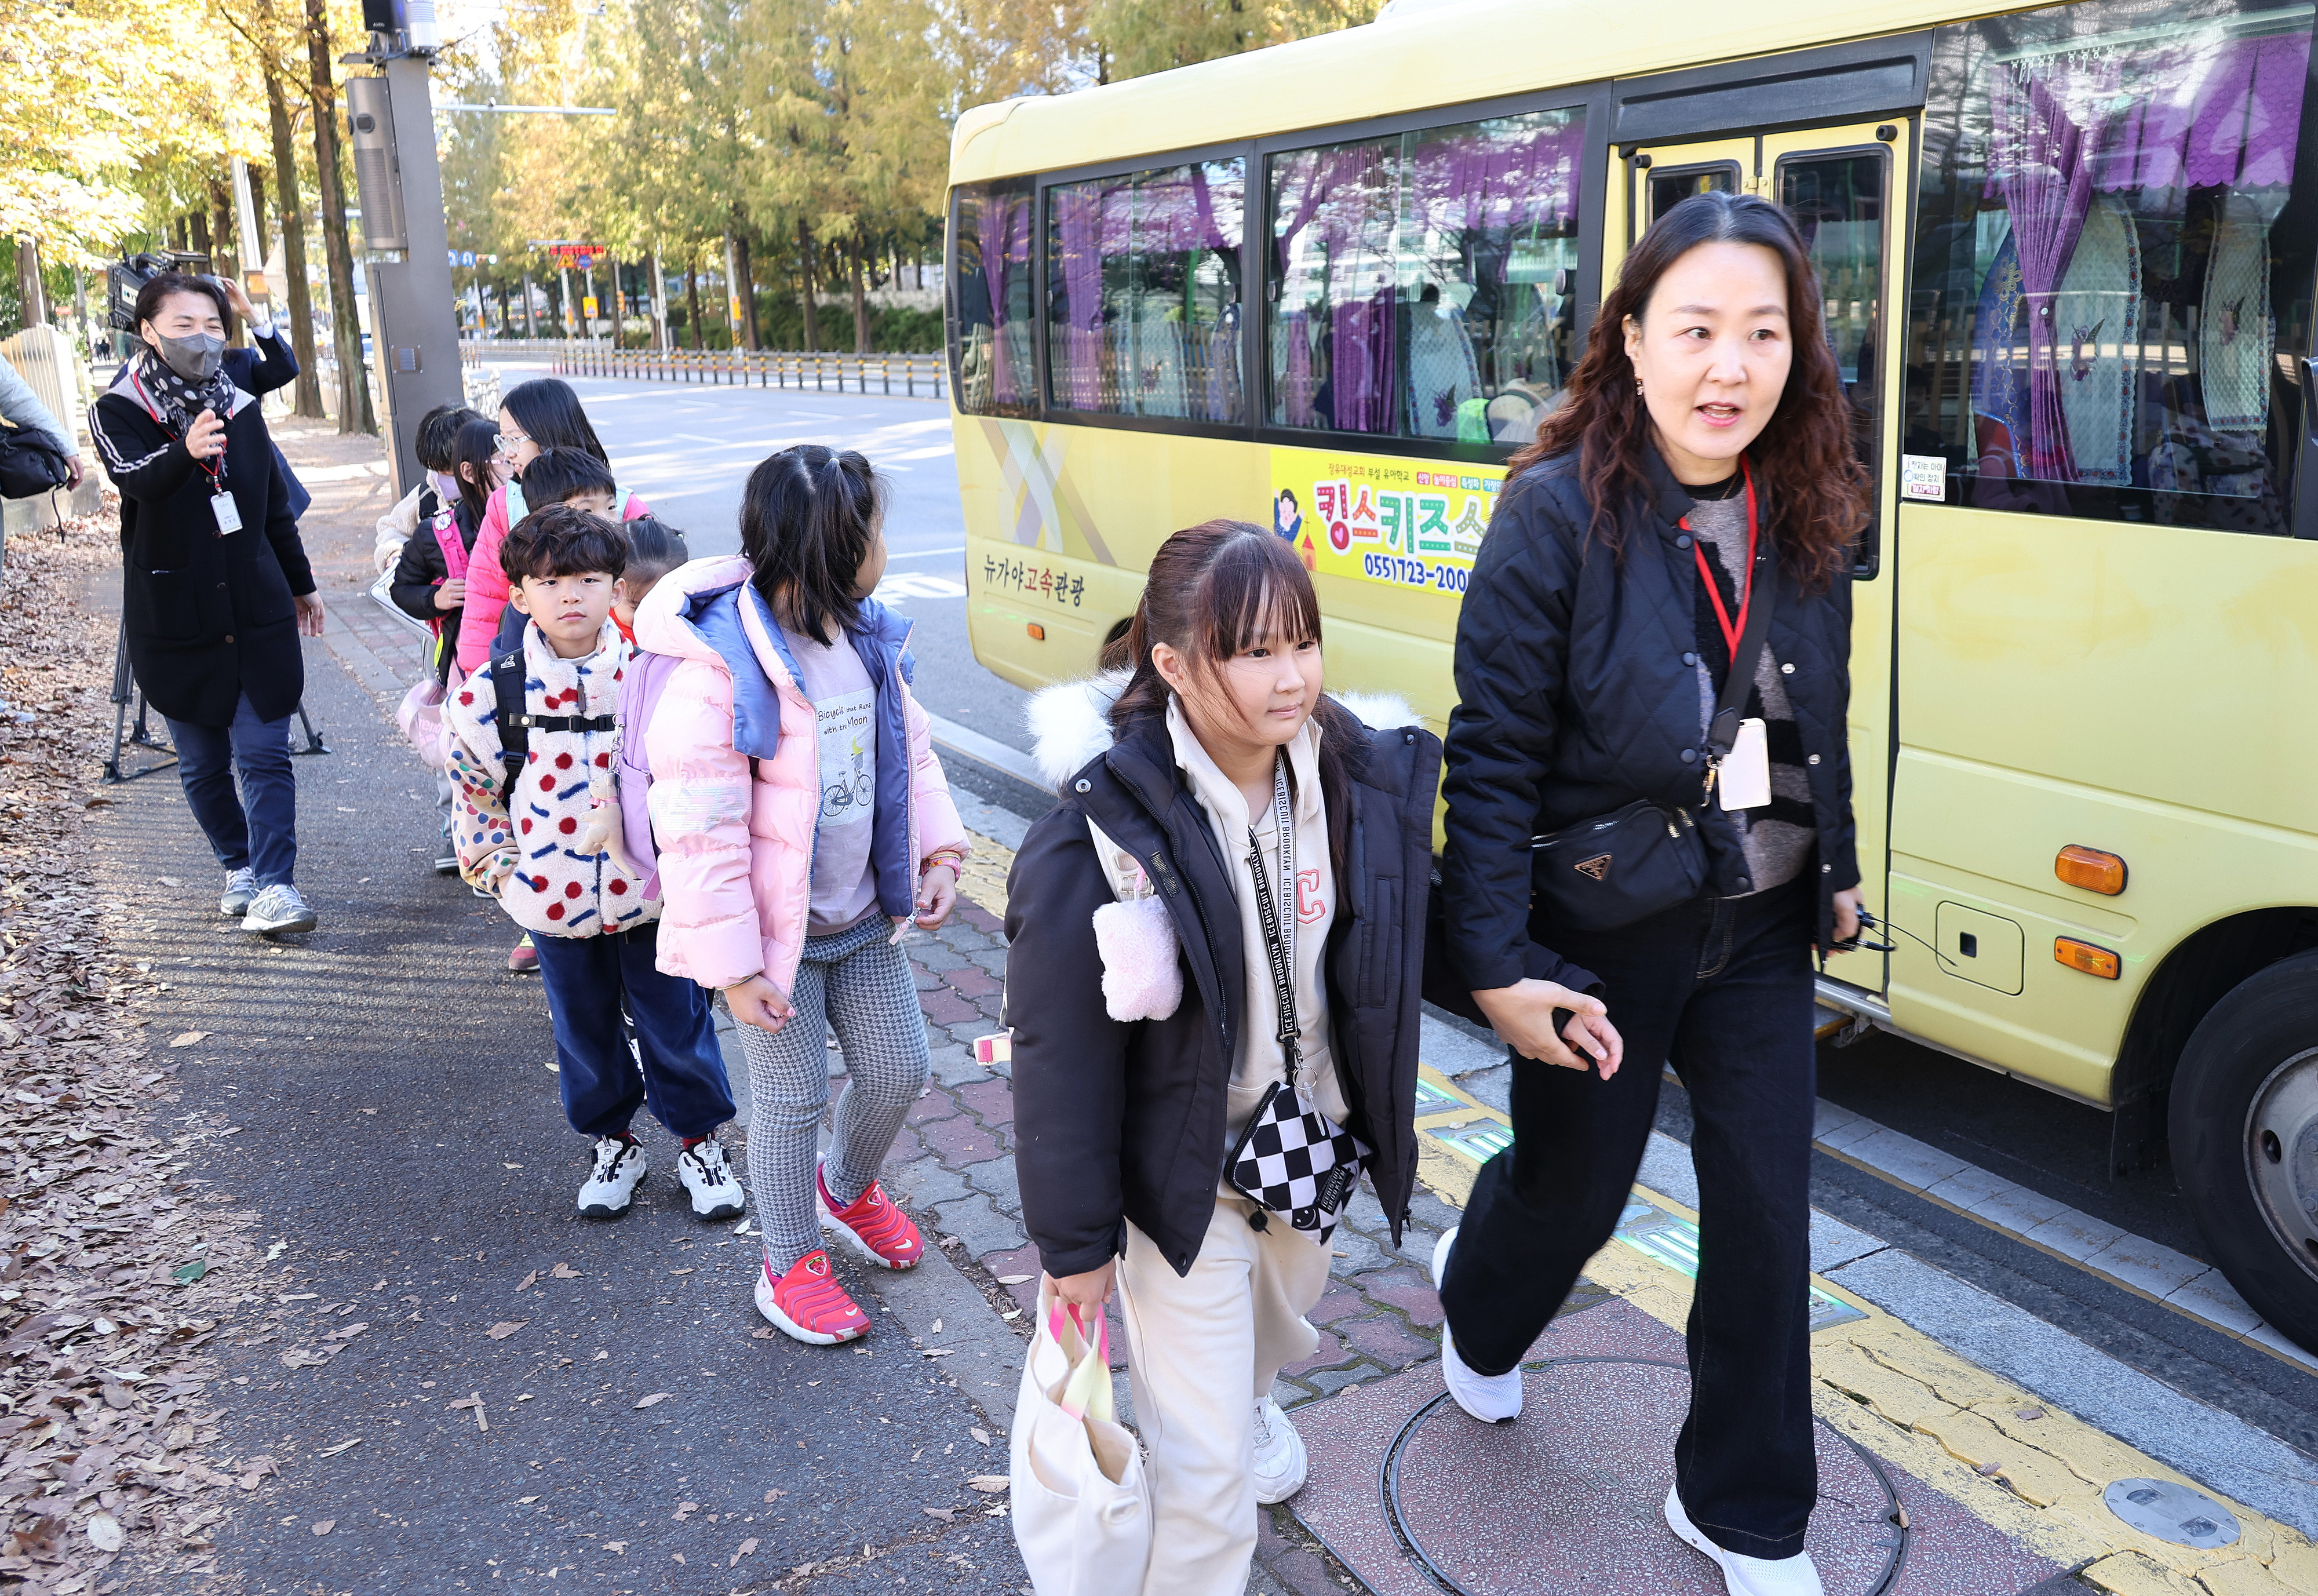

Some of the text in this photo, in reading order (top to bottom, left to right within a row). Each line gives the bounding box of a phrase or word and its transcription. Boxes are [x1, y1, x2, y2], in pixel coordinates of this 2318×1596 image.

[1329, 463, 1409, 482] 장유대성교회 부설 유아학교
[1433, 474, 1457, 487] 놀이중심
[1461, 477, 1480, 490] 특성화
[1928, 474, 1939, 483] 장치
[984, 553, 1085, 607] 뉴가야고속관광
[1365, 554, 1471, 592] 055)723-200
[818, 705, 844, 722] Bicycle
[823, 726, 837, 735] with
[847, 716, 868, 728] Moon
[1249, 846, 1294, 1032] ICEBISCUIT BROOKLYN ICEBISCUIT BROOKLYN
